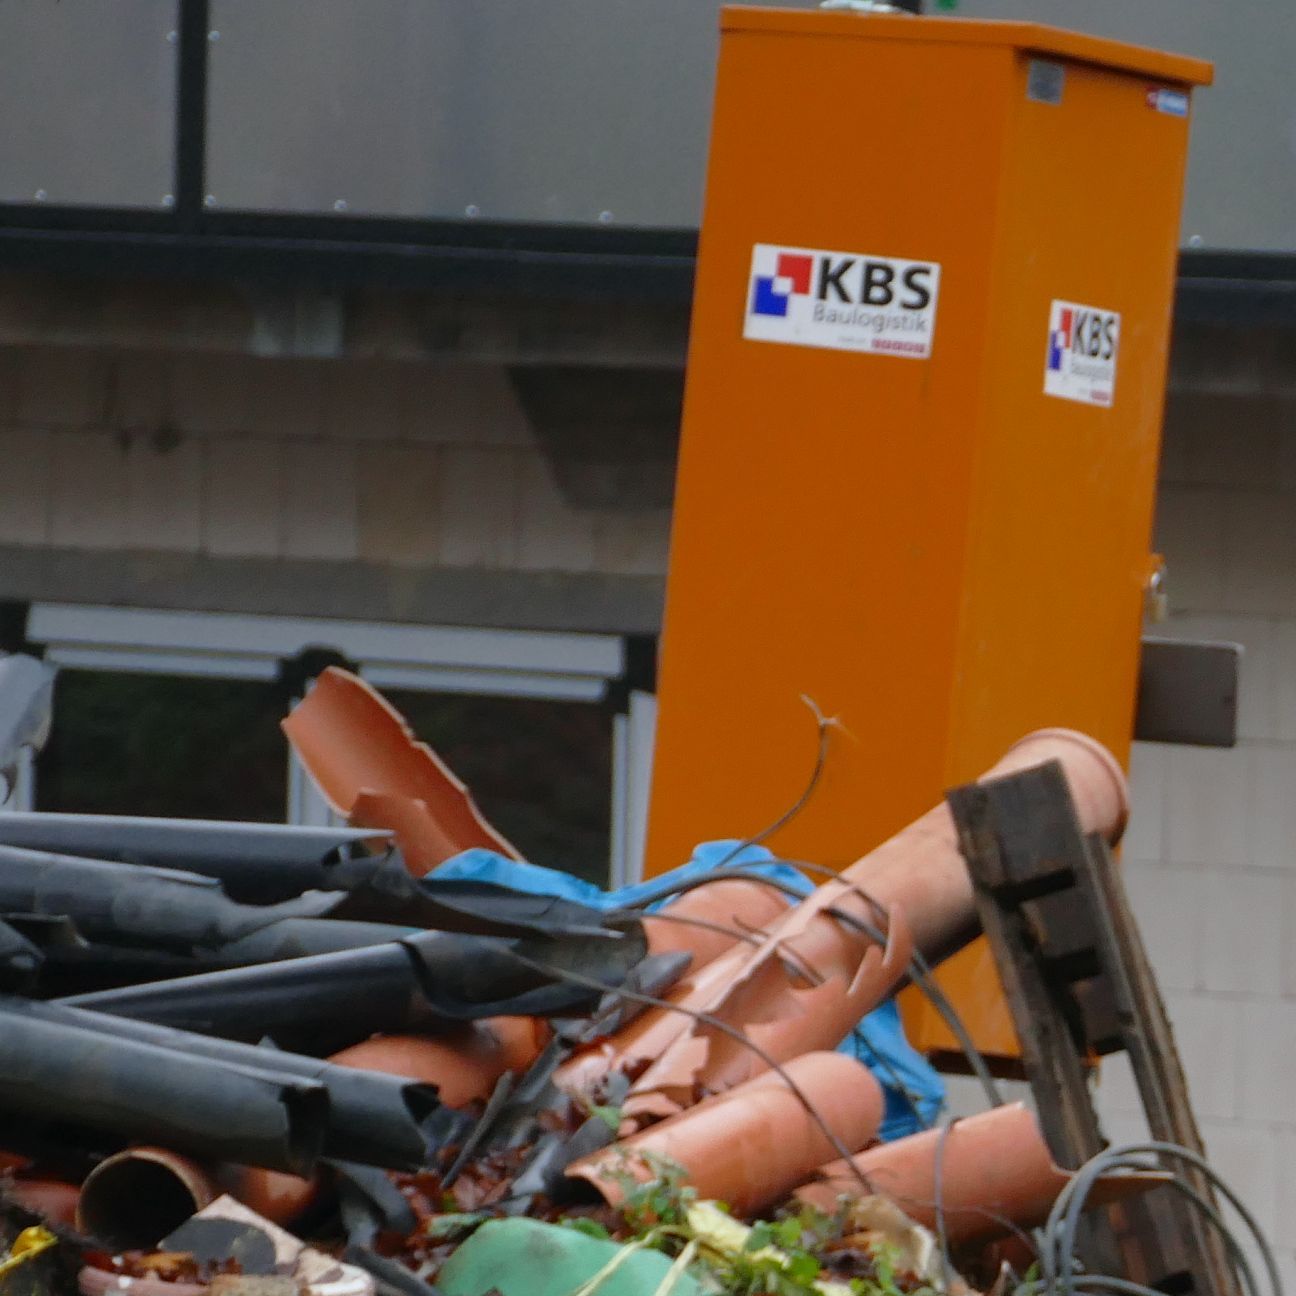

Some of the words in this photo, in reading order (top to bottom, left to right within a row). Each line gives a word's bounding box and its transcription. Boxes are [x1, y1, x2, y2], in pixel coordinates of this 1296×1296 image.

[817, 257, 932, 311] KBS
[812, 304, 928, 334] Baulogistik
[1071, 308, 1115, 362] KBS
